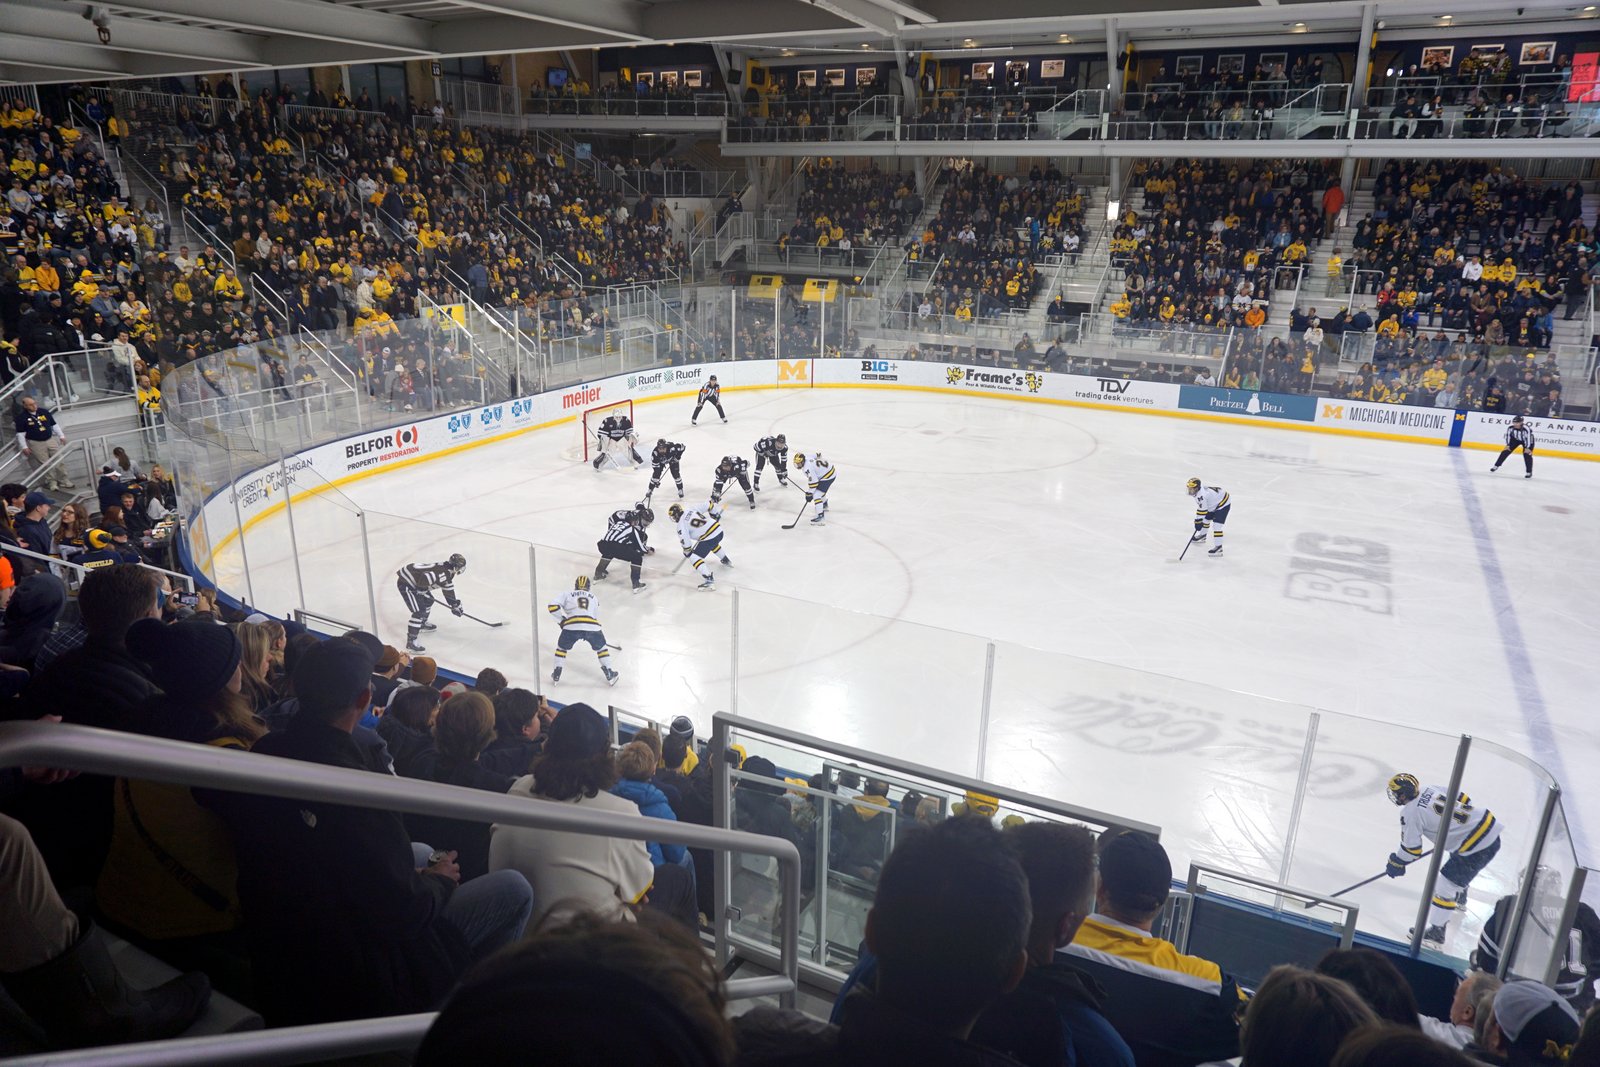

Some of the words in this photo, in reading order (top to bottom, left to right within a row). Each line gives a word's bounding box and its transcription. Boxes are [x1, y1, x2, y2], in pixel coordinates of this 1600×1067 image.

[638, 372, 662, 386] Ruoff
[675, 368, 702, 380] Ruoff
[778, 360, 808, 381] M
[966, 368, 1024, 386] Frame's
[1097, 378, 1131, 394] TDV
[563, 385, 601, 409] meijer
[1075, 391, 1101, 400] trading
[1103, 393, 1121, 401] desk
[1122, 396, 1154, 405] ventures
[1322, 404, 1344, 419] M
[1350, 407, 1397, 425] MICHIGAN
[1399, 411, 1447, 430] MEDICINE
[1481, 417, 1517, 426] LEXU
[1526, 421, 1541, 429] OF
[1547, 423, 1574, 431] ANN
[1580, 426, 1600, 434] AR
[346, 435, 393, 458] BELFOR
[347, 456, 379, 471] PROPERTY
[380, 446, 420, 462] RESTORATION
[265, 472, 275, 484] OF
[276, 457, 313, 477] MCHIGAN
[242, 489, 263, 508] CREDIT
